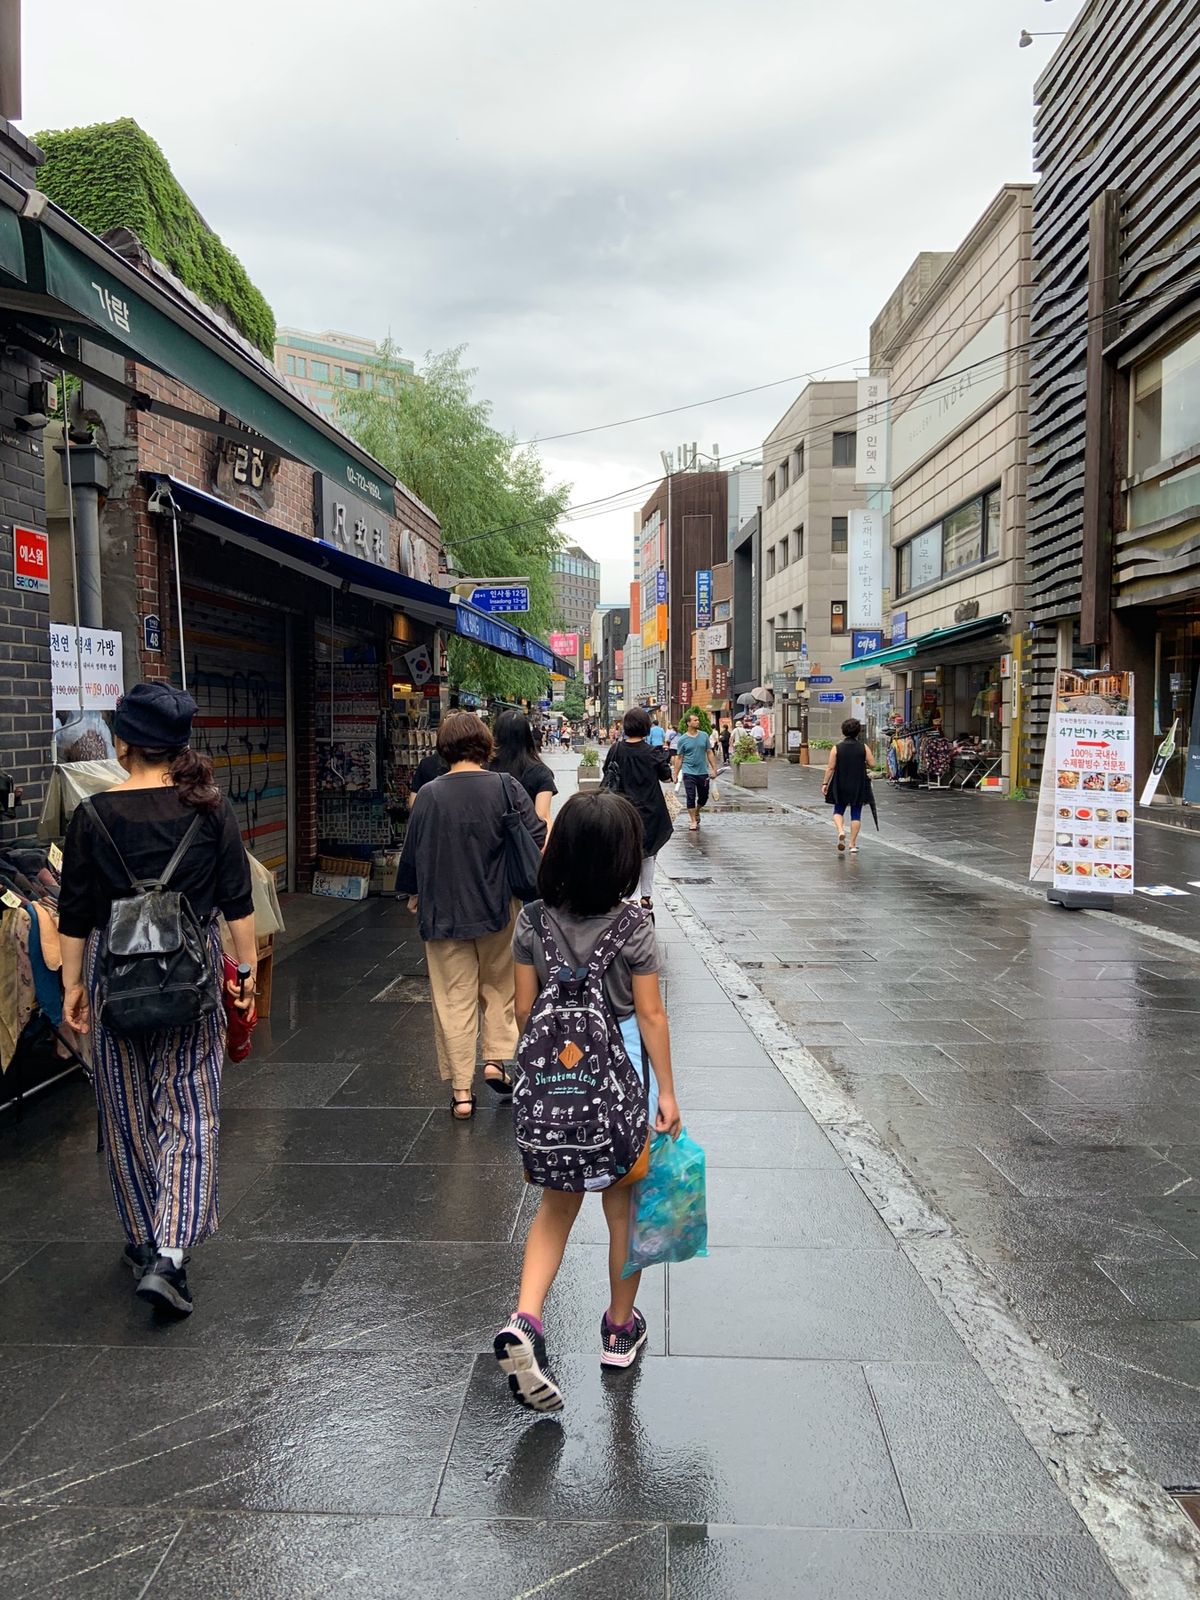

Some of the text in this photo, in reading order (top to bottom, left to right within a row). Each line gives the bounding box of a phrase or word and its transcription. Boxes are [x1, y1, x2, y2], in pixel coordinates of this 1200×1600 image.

[91, 281, 130, 333] 가람
[865, 385, 878, 474] 갤러리 인덱스
[19, 545, 44, 566] 에스원
[490, 589, 527, 599] 인사동12길
[51, 633, 70, 653] 천연
[96, 638, 116, 657] 가방
[150, 632, 159, 647] 48
[1059, 727, 1130, 741] 47번가 찻집
[1070, 748, 1118, 761] 100% 국내산
[1102, 760, 1126, 771] 전문점
